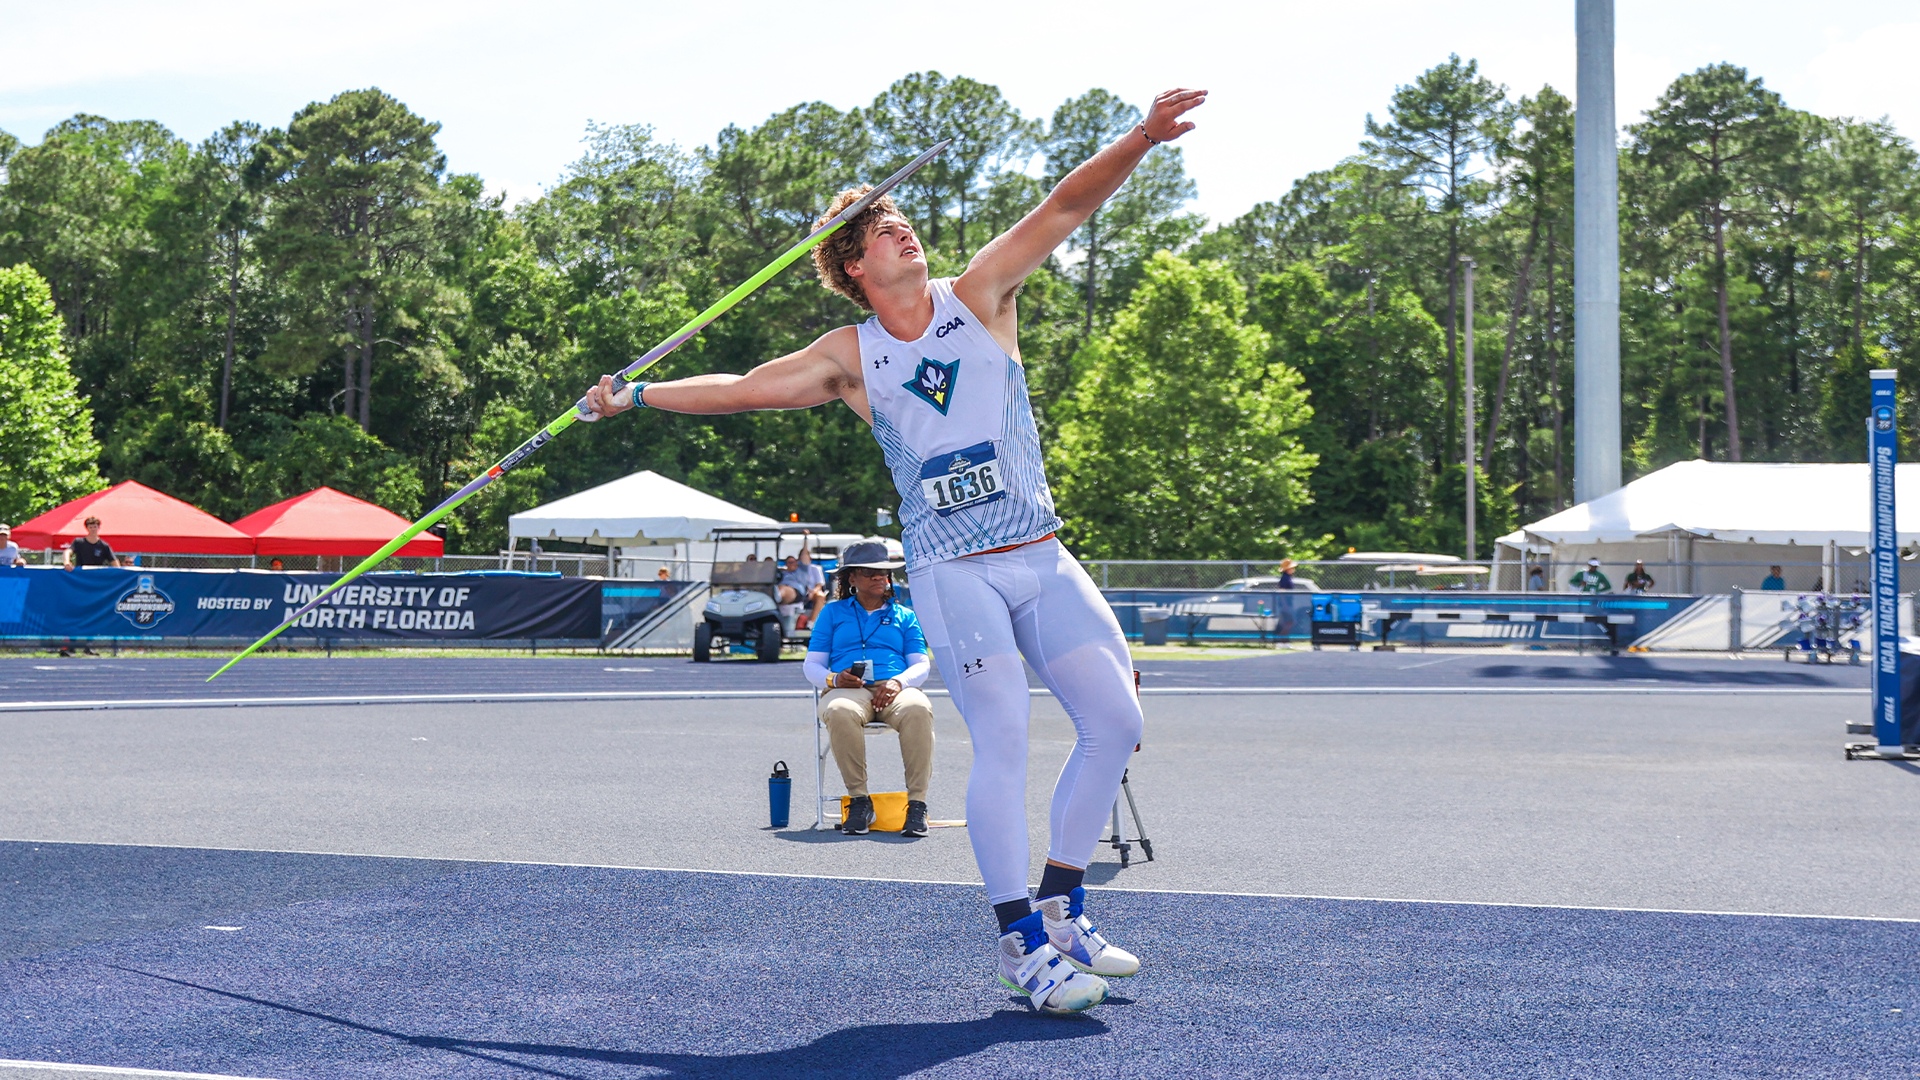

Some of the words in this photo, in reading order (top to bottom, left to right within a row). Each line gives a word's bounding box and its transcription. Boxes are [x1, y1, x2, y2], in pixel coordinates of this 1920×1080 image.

[936, 316, 965, 338] CAA
[933, 465, 996, 508] 1636
[1877, 446, 1894, 549] CHAMPIONSHIPS
[1879, 551, 1895, 585] FIELD
[197, 597, 251, 610] HOSTED
[253, 598, 273, 610] BY
[283, 583, 435, 607] UNIVERSITY
[438, 587, 470, 607] OF
[1879, 586, 1895, 597] &
[284, 607, 367, 629] NORTH
[372, 609, 475, 630] FLORIDA
[1879, 597, 1895, 637] TRACK
[1880, 641, 1896, 674] NCAA
[1884, 695, 1895, 724] GILL
